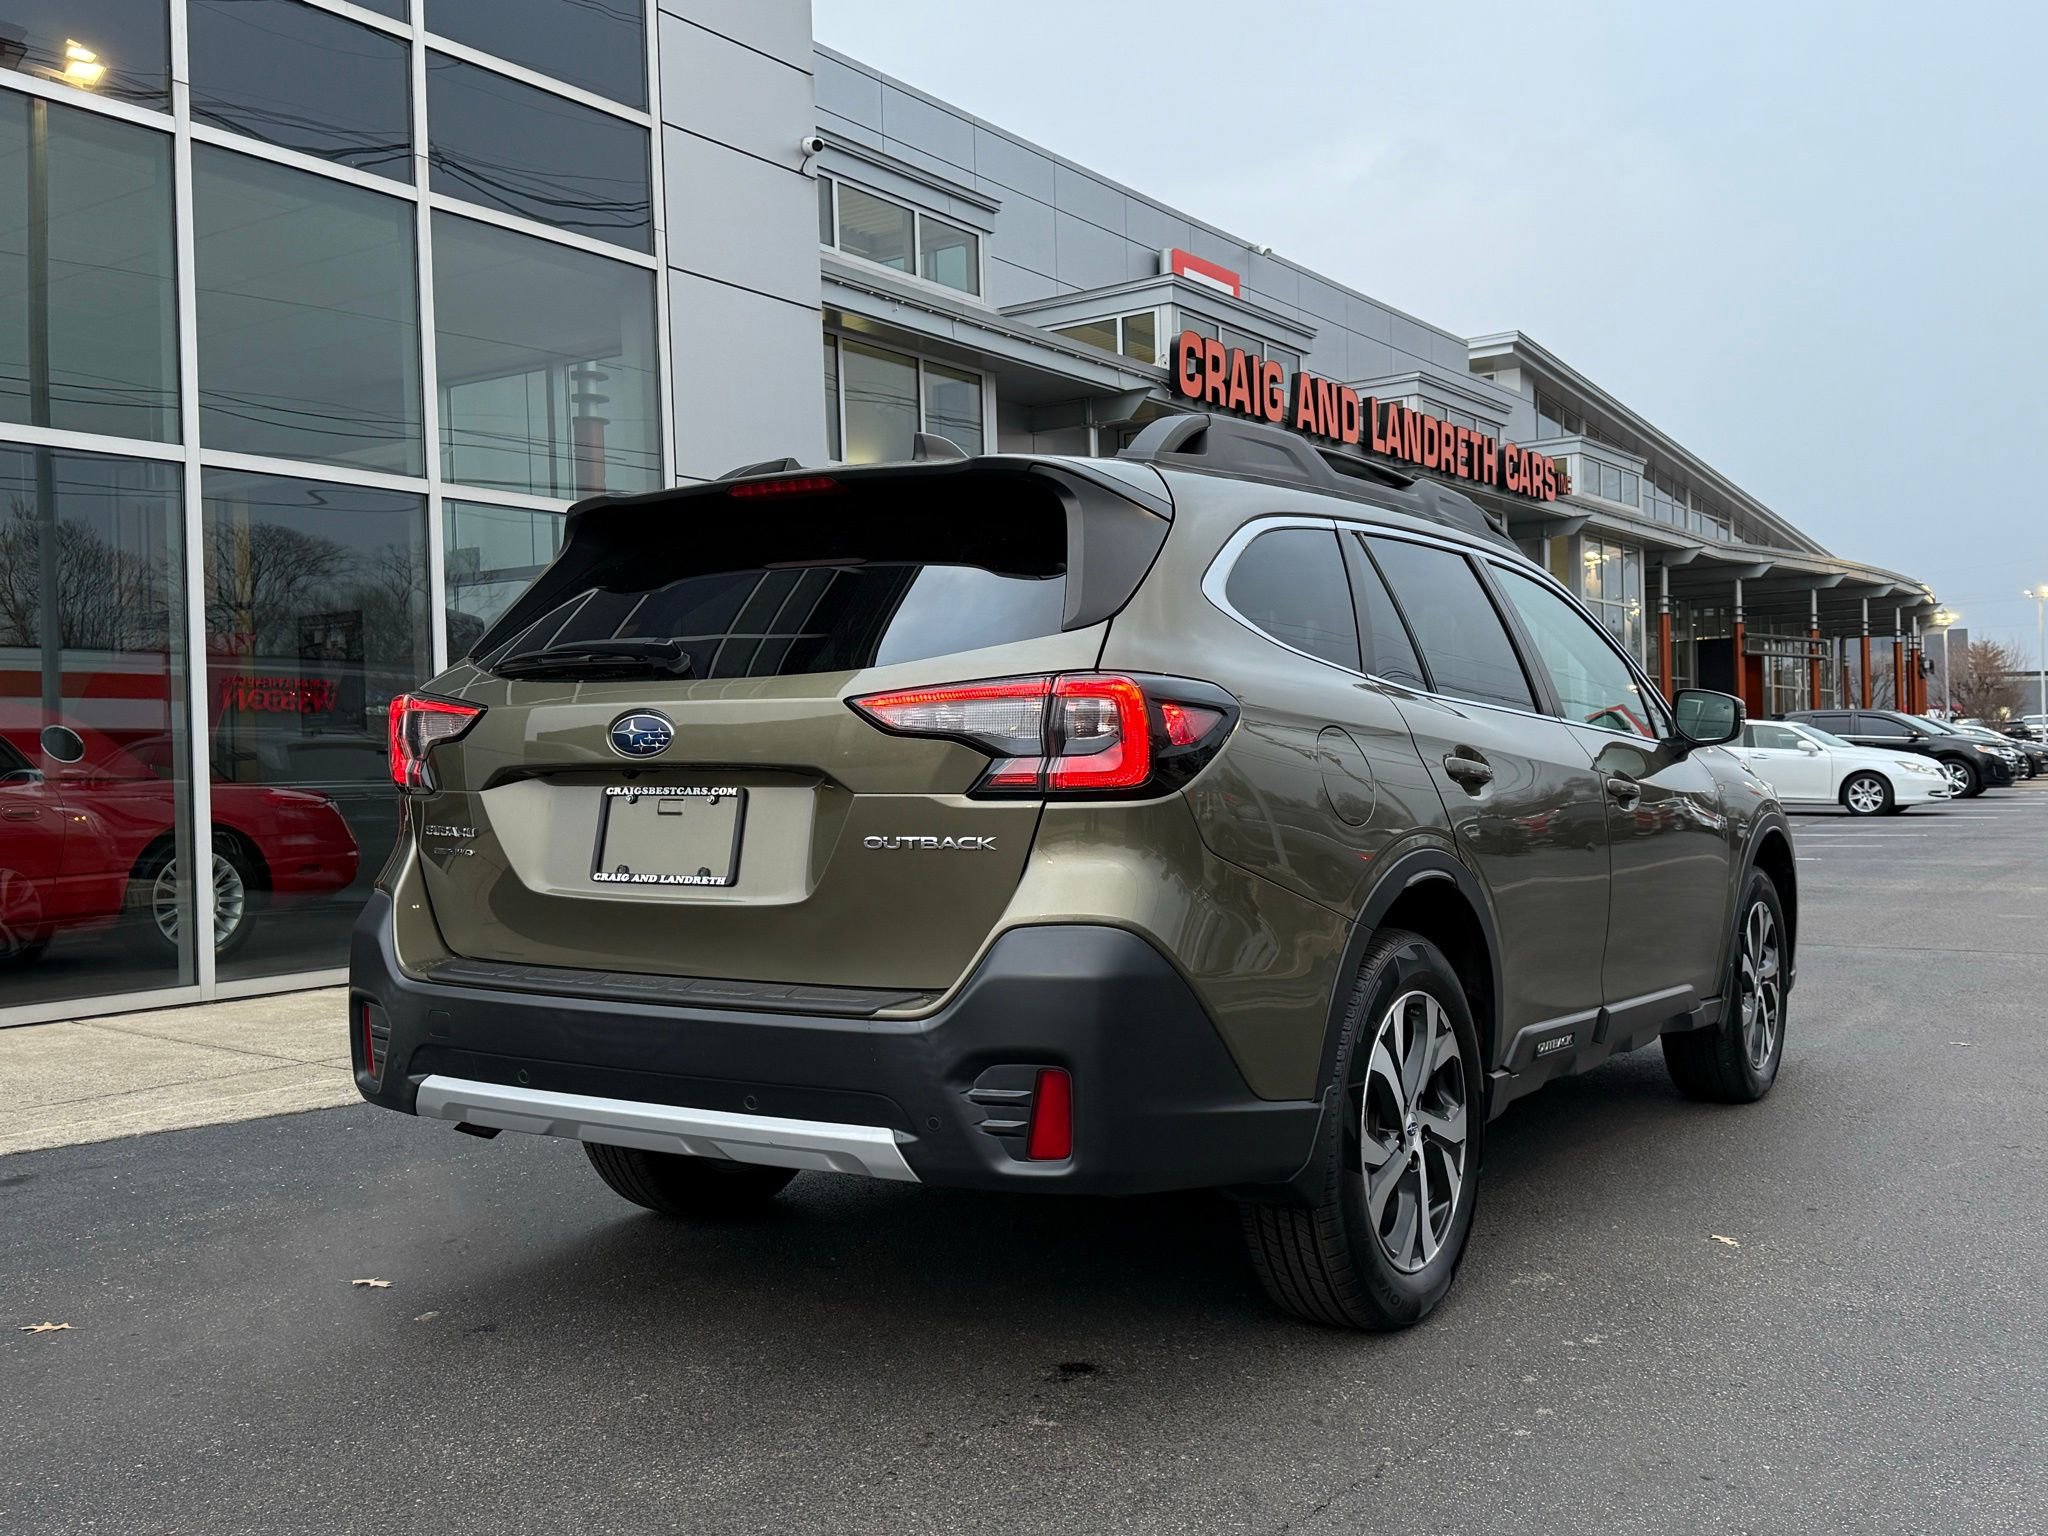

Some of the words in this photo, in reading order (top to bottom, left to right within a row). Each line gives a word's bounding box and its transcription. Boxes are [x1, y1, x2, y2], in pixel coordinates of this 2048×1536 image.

[1177, 329, 1284, 423] CRAIG
[1295, 371, 1360, 445] AND
[1369, 396, 1499, 486] LANDRETH
[1504, 441, 1557, 502] CARS
[605, 786, 738, 797] CRAIGSBESTCARS.COM
[862, 835, 998, 851] OUTBACK
[593, 872, 630, 882] CRAIG
[631, 873, 658, 883] AND
[659, 875, 727, 886] LANDRETH
[1537, 1033, 1574, 1053] OUTBACK
